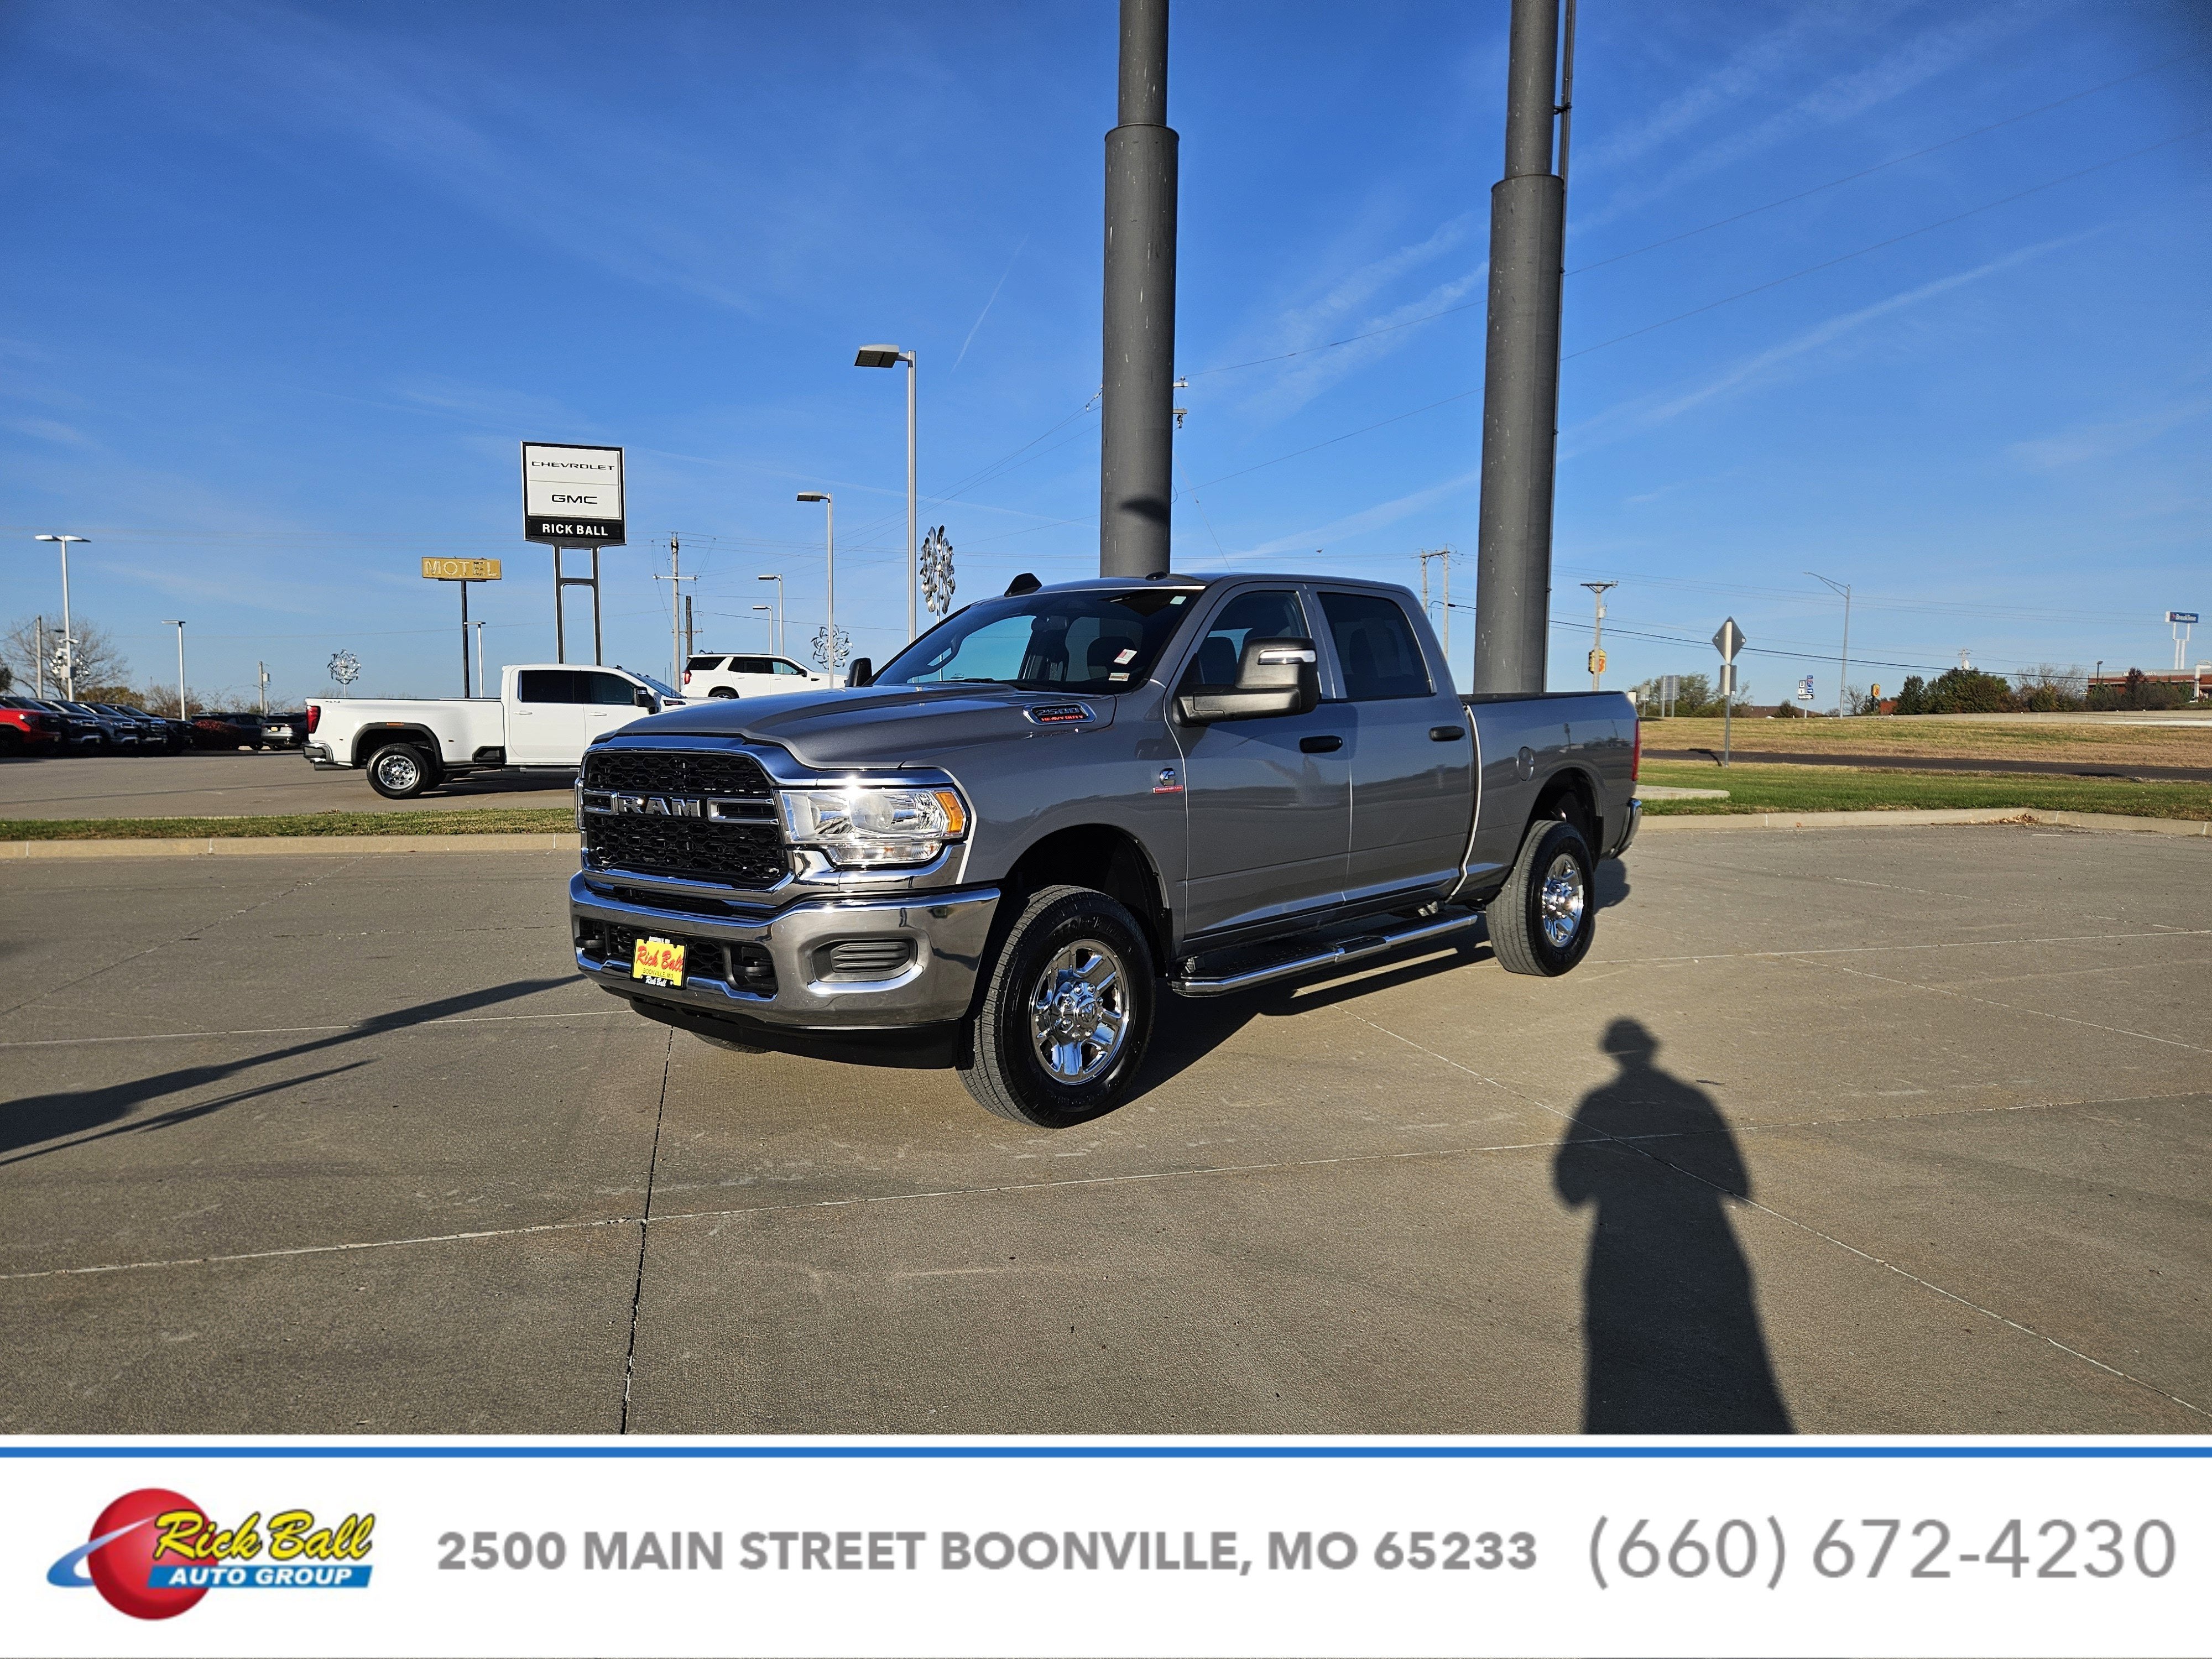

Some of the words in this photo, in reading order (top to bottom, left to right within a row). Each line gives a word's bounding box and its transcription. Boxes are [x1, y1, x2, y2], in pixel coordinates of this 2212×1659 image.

[531, 461, 615, 470] CHEVROLET
[551, 494, 598, 504] GMC
[542, 523, 573, 534] RICK
[576, 525, 608, 536] BALL
[425, 560, 498, 576] MOTEL
[1036, 707, 1080, 716] 2500
[617, 793, 701, 817] RAM
[636, 945, 659, 967] Rick
[661, 950, 684, 972] Ball
